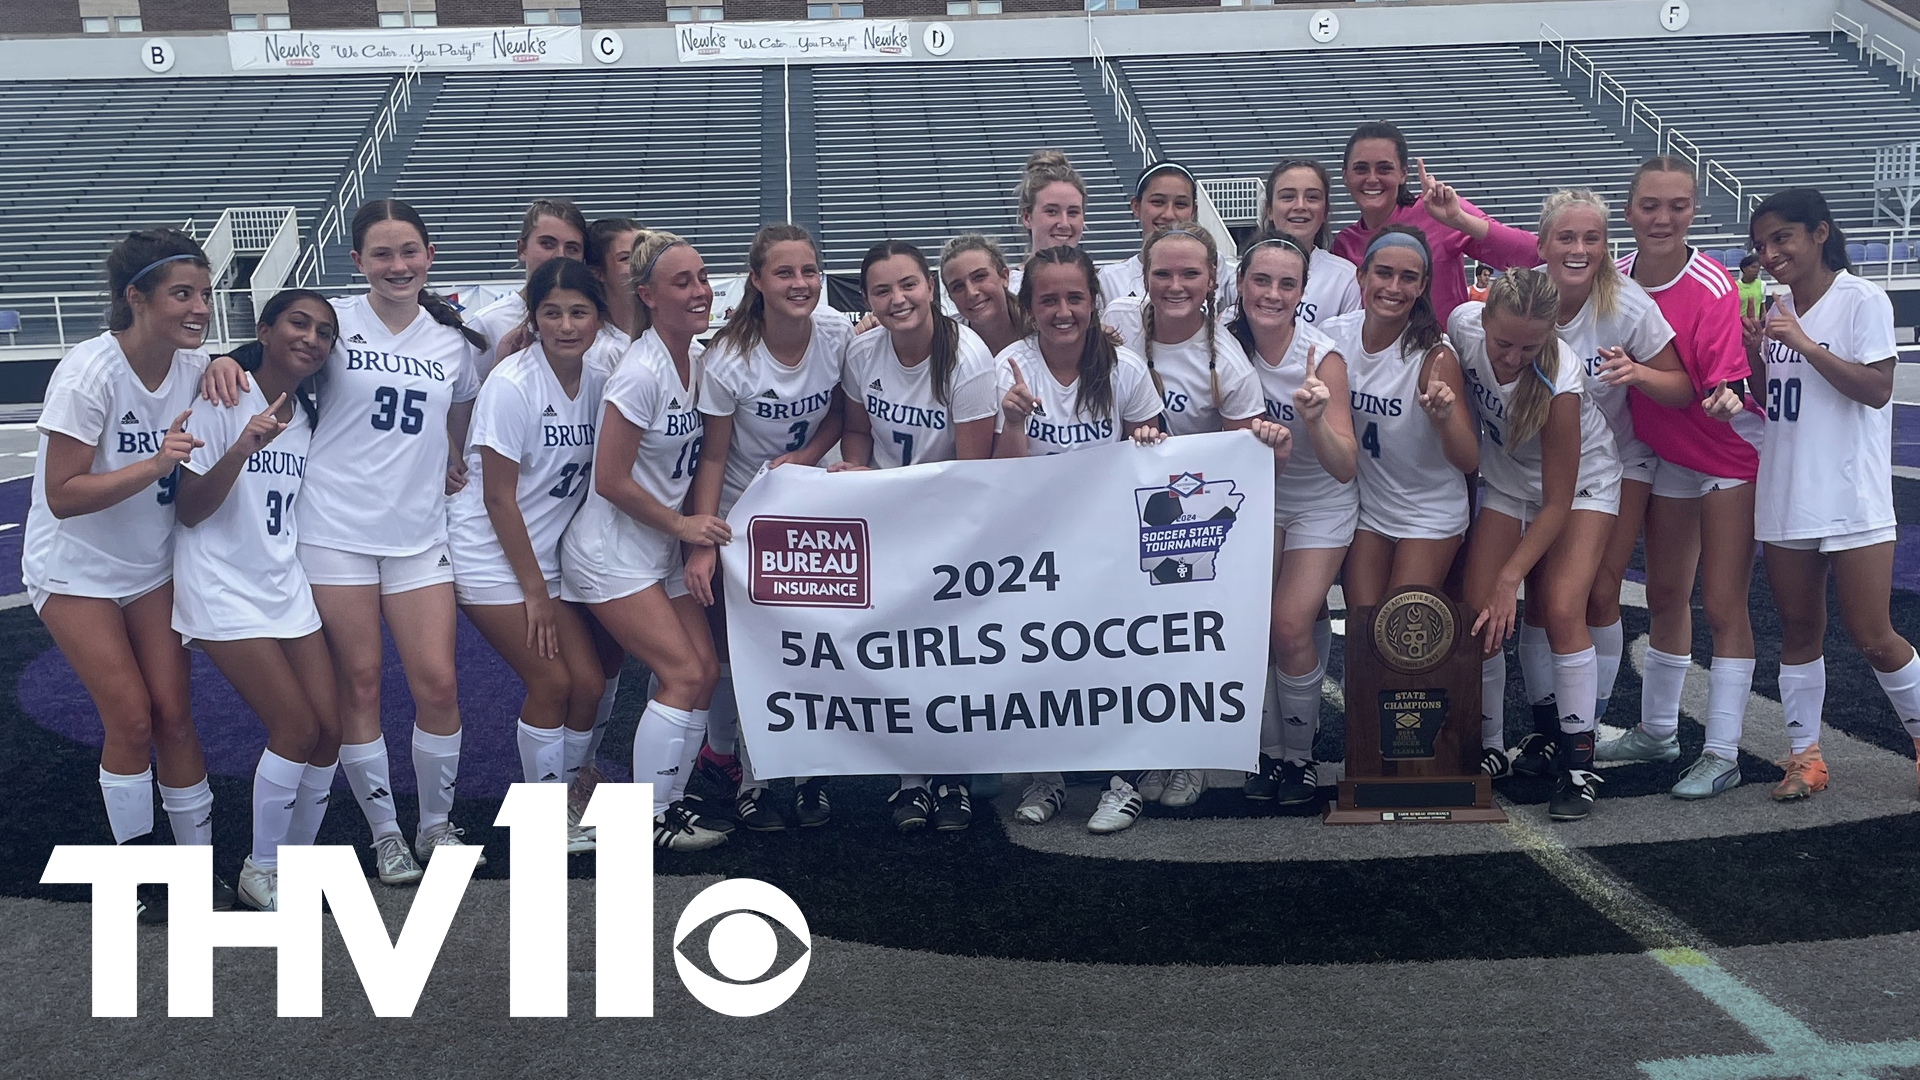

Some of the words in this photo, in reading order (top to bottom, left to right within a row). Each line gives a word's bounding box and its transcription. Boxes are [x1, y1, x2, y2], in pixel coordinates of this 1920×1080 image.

[1318, 17, 1330, 35] E
[1670, 6, 1680, 24] F
[264, 33, 321, 63] Newk's
[493, 29, 547, 58] Newk's
[600, 36, 615, 55] C
[681, 27, 726, 52] Newk's
[864, 27, 908, 50] Newk's
[932, 30, 945, 48] D
[151, 46, 165, 64] B
[331, 45, 359, 58] "We
[346, 349, 446, 381] BRUINS
[371, 385, 428, 435] 35
[755, 389, 831, 420] BRUIN
[866, 394, 946, 430] BRUINS
[1350, 390, 1402, 416] UINS
[1767, 377, 1802, 422] 30
[117, 428, 169, 453] BRU
[544, 423, 595, 447] BRUIN
[786, 419, 810, 452] 3
[1027, 416, 1113, 446] BRUINS
[1360, 420, 1381, 459] 4
[892, 430, 914, 467] 7
[247, 450, 306, 479] BRUIN
[266, 490, 295, 536] 3
[1176, 514, 1197, 522] 2024
[786, 529, 856, 550] FARM
[1141, 529, 1187, 543] SOCCER
[1188, 525, 1224, 538] STATE
[1145, 535, 1225, 553] TOURNAMENT
[761, 551, 858, 574] BUREAU
[932, 551, 1060, 601] 2024
[773, 581, 858, 597] INSURANCE
[1375, 606, 1392, 644] ARKANSAS
[1391, 594, 1430, 607] ACTIVITIES
[1430, 599, 1454, 640] ASSOCIATION
[781, 630, 845, 670] 5A
[856, 623, 1005, 670] GIRLS
[1020, 611, 1226, 664] SOCCER
[766, 691, 914, 734] STATE
[925, 681, 1246, 734] CHAMPIONS
[1383, 701, 1442, 710] CHAMPIONS
[1395, 691, 1426, 701] STATE
